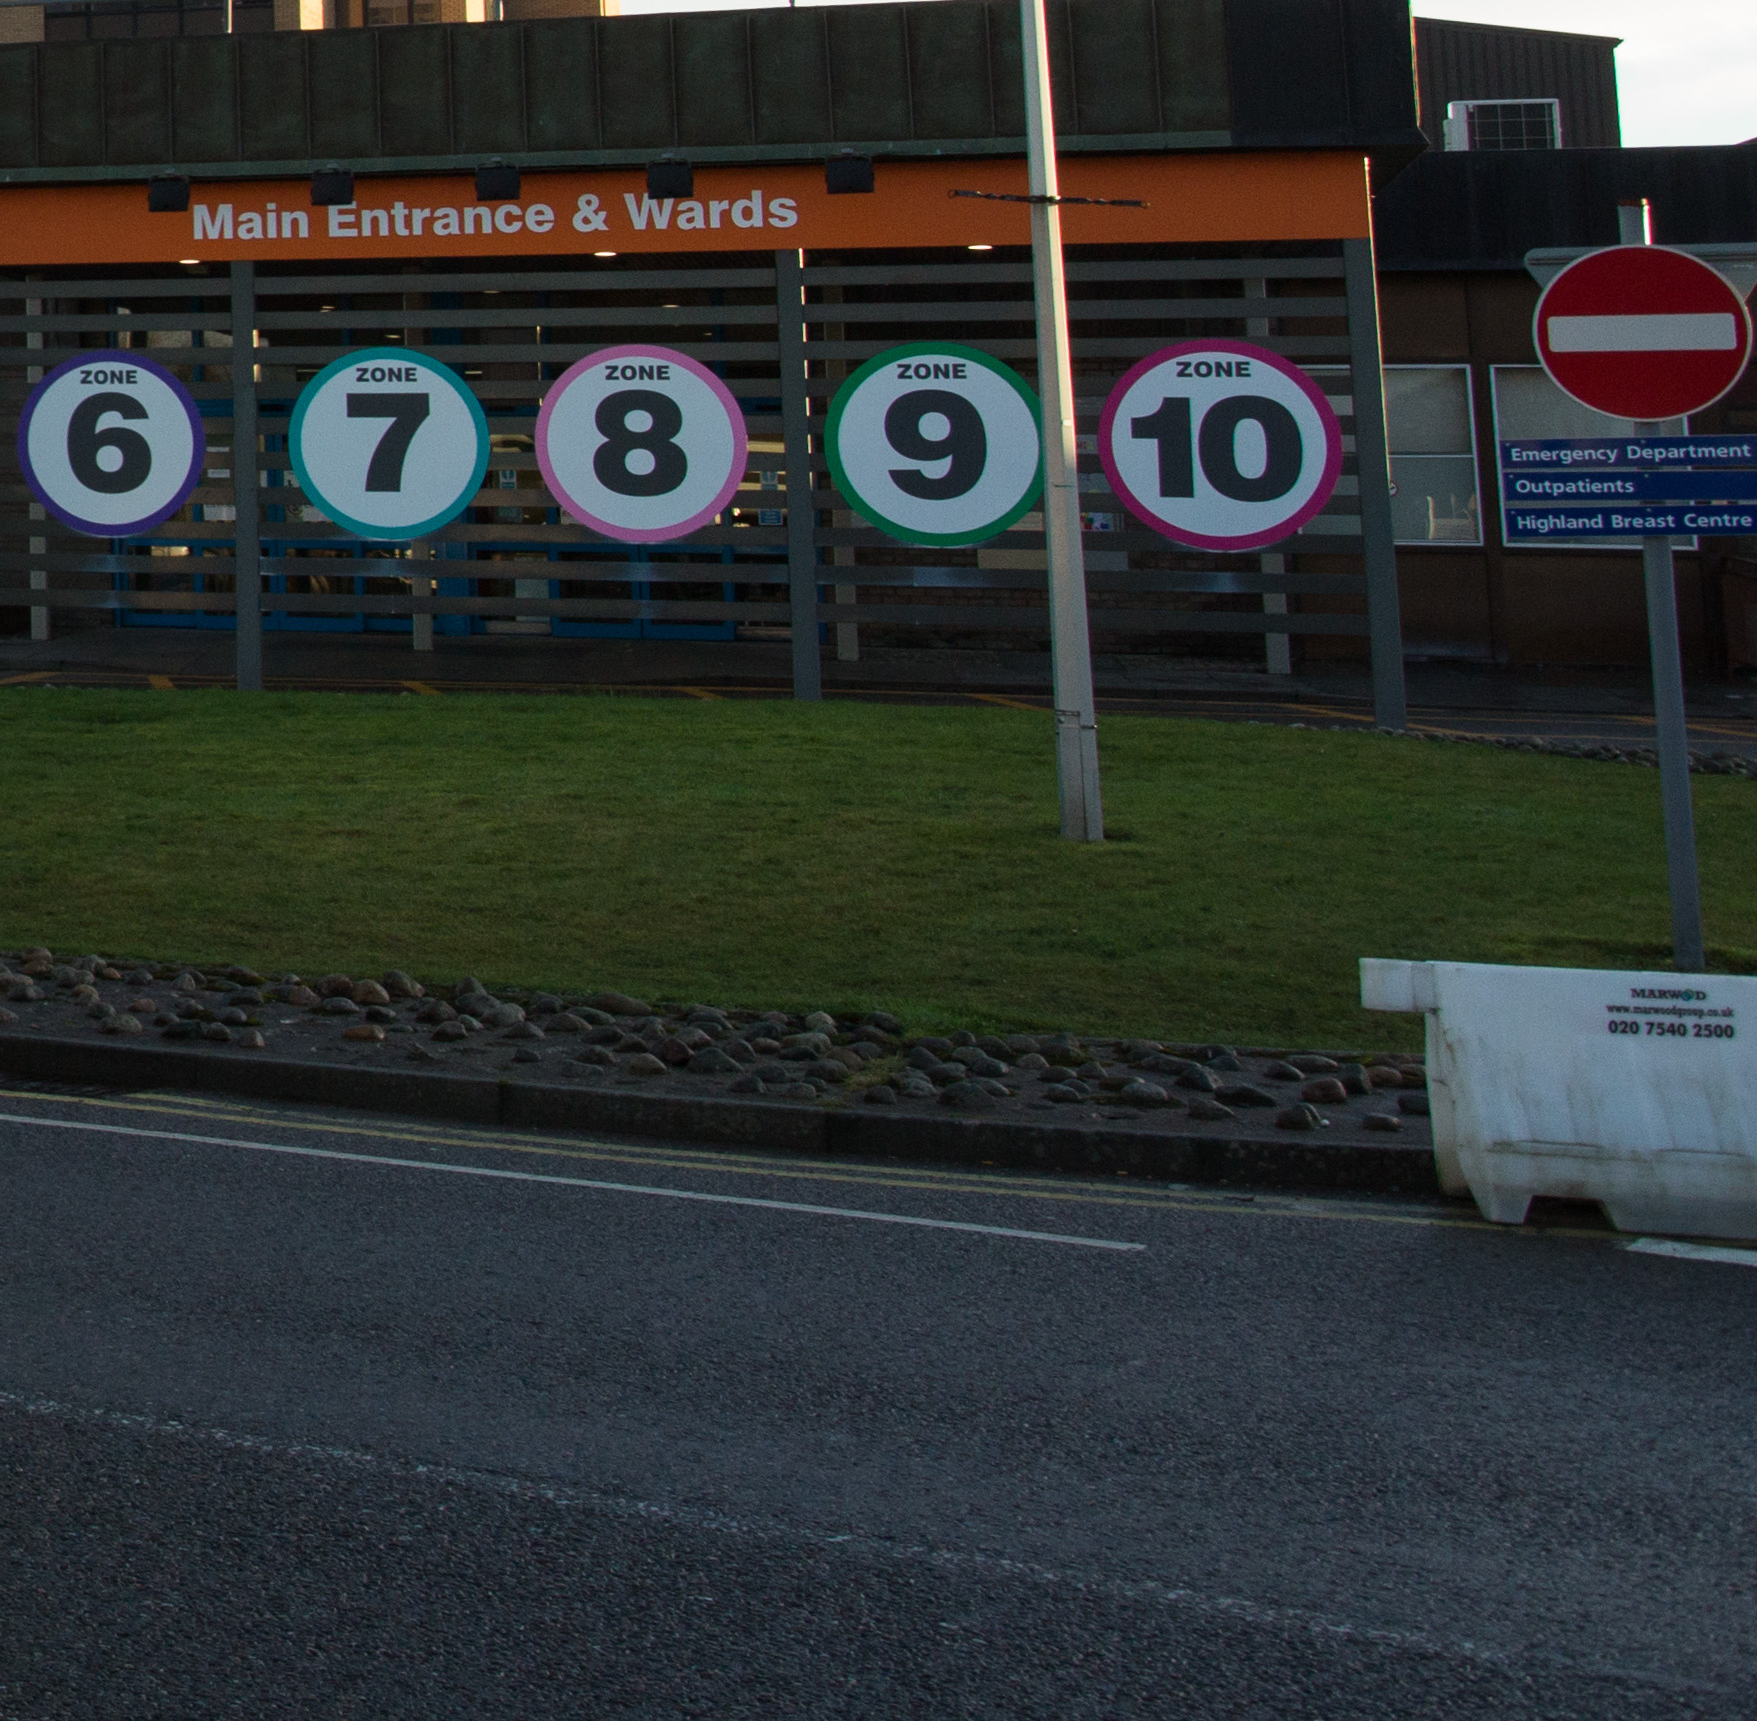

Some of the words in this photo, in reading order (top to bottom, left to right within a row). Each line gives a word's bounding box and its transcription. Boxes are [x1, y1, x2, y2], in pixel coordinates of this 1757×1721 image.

[192, 203, 309, 240] Main
[328, 200, 555, 238] Entrance
[572, 193, 609, 233] &
[623, 189, 798, 230] Wards
[79, 369, 138, 385] ZONE
[355, 366, 418, 383] ZONE
[604, 365, 671, 381] ZONE
[896, 363, 967, 380] ZONE
[1175, 361, 1251, 378] ZONE
[66, 391, 152, 494] 6
[345, 392, 430, 493] 7
[592, 388, 688, 497] 8
[884, 388, 987, 501] 9
[1130, 394, 1303, 503] 10
[1510, 448, 1618, 464] Emergency
[1627, 444, 1752, 462] Department
[1515, 478, 1635, 496] Outpatients
[1517, 514, 1603, 533] Highland
[1611, 514, 1675, 528] Breast
[1683, 512, 1752, 527] Centre
[1606, 1005, 1734, 1018] www.marwoodgroup.co.uk
[1608, 1020, 1639, 1035] 020
[1645, 1021, 1687, 1037] 7540
[1692, 1023, 1735, 1039] 2500
